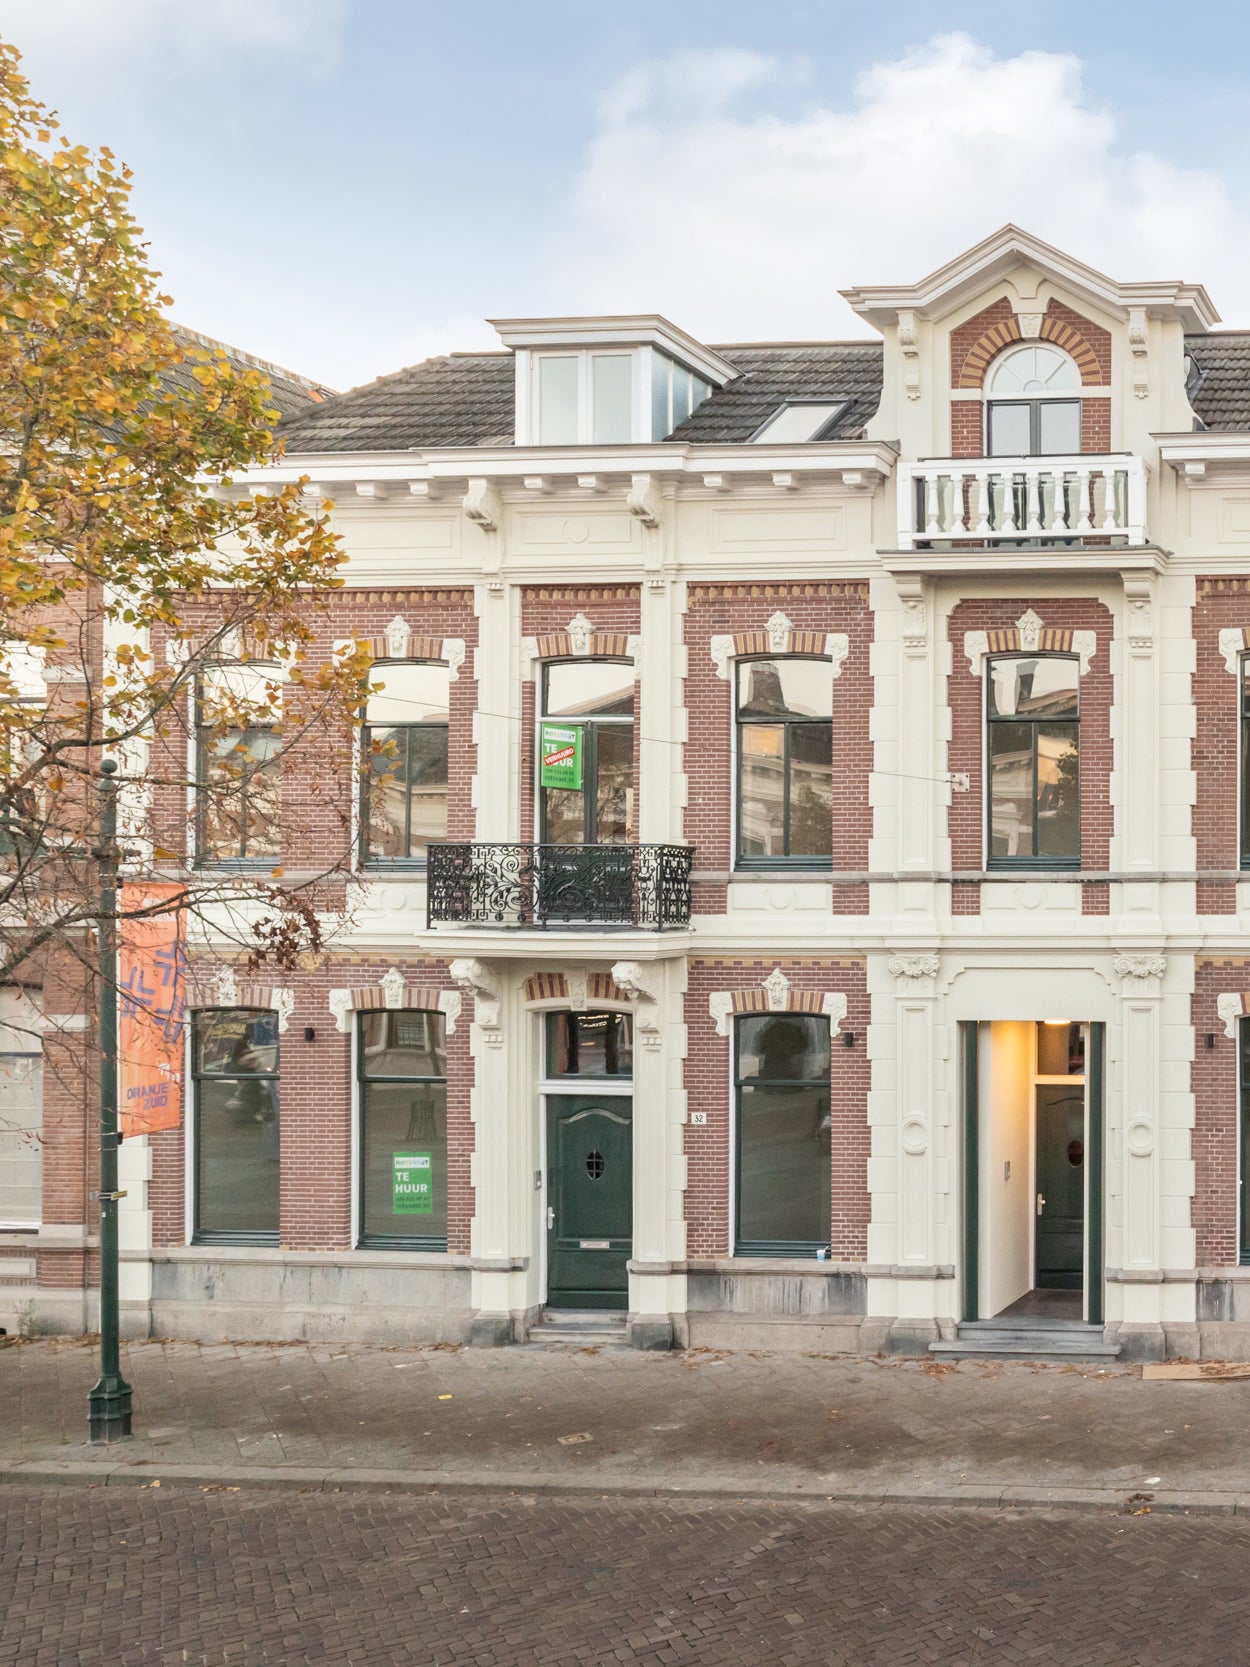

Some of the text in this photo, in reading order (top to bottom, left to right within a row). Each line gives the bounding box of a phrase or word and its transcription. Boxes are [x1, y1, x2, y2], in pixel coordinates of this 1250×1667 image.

[545, 743, 557, 753] TE
[127, 1082, 168, 1100] ORANJE
[144, 1096, 168, 1110] ZUID
[396, 1172, 409, 1181] TE
[396, 1184, 428, 1193] HUUR
